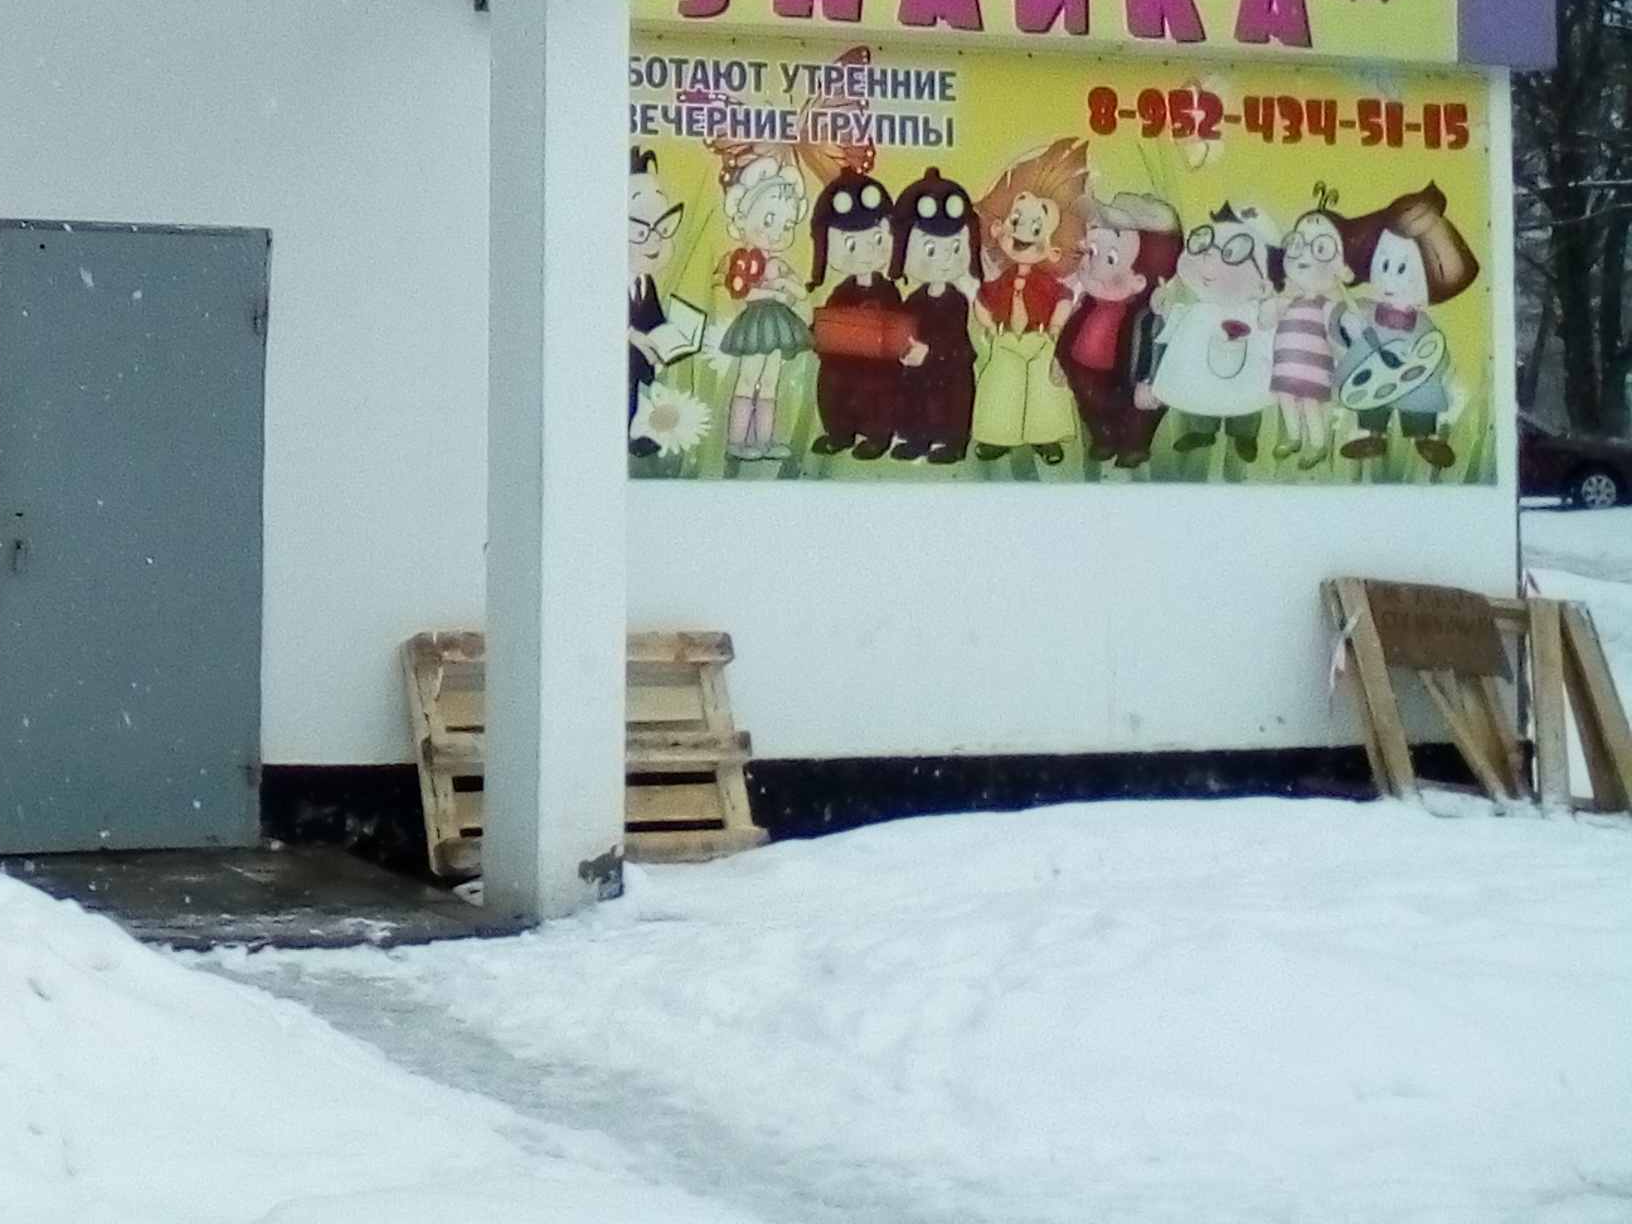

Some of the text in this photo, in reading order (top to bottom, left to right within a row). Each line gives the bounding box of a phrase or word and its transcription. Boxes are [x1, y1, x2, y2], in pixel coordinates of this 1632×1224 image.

[780, 61, 957, 102] УТРЕННИЕ
[810, 110, 954, 148] ГРУППЫ
[1087, 86, 1470, 150] 8-952-434-51-15
